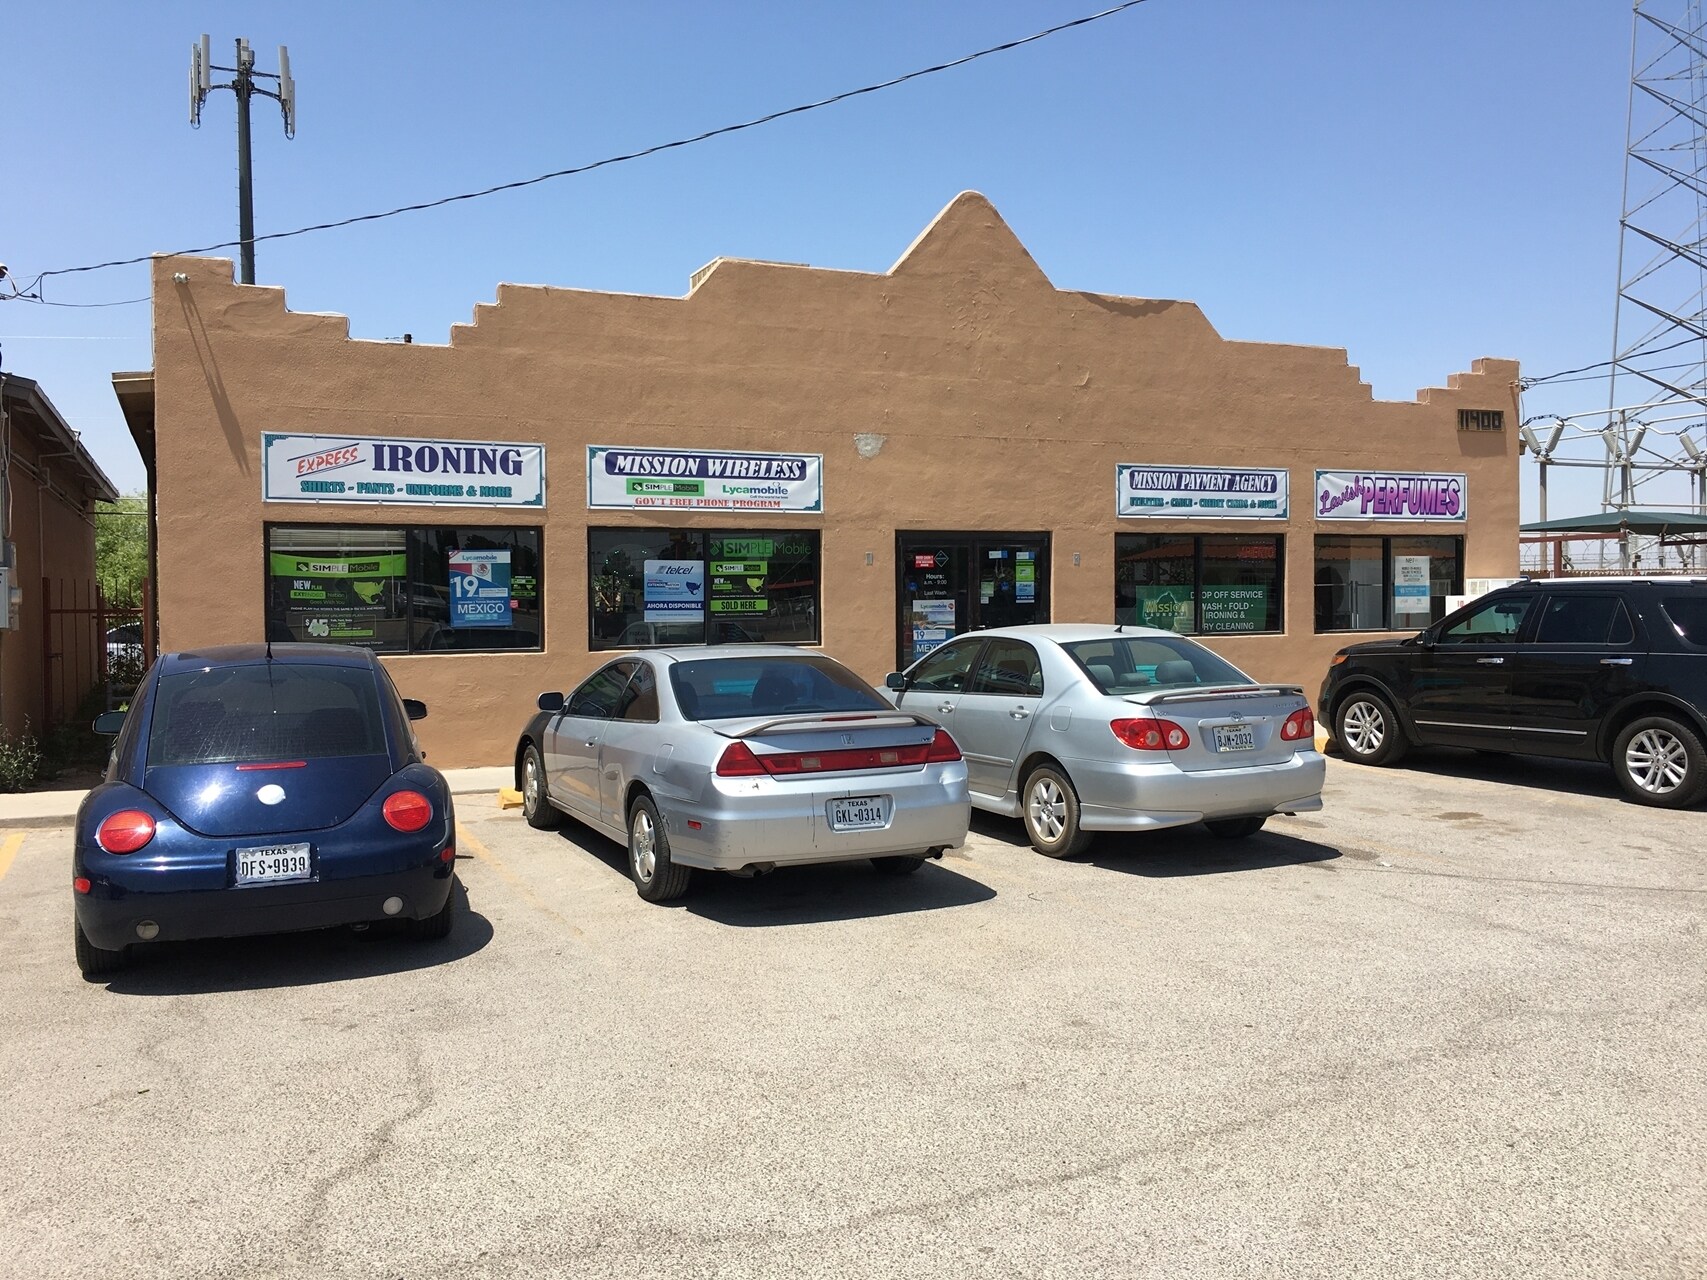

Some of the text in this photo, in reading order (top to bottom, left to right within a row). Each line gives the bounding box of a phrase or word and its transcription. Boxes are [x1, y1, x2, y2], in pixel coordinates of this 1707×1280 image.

[297, 446, 358, 475] EXPRESS
[372, 444, 523, 476] IRONING
[614, 455, 802, 479] MISSION WIRELESS
[1132, 472, 1275, 492] MISSION PAYMENT AGENCY
[301, 480, 345, 494] SHIRTS
[357, 482, 395, 495] PANTS
[406, 484, 463, 497] UNIFORMS
[466, 485, 477, 497] &
[479, 485, 512, 498] MORE
[644, 483, 673, 492] SIMPLE
[722, 484, 788, 496] Lycamobile
[1319, 475, 1365, 515] Lavish
[1360, 476, 1461, 516] PERFUMES
[635, 497, 781, 508] GOV'T FREE PHONE PROGRAM
[726, 541, 812, 555] SIMPLE Mobile
[312, 562, 379, 572] SIMPLE Mobile
[666, 566, 694, 575] telcel
[294, 580, 311, 590] NEW
[1190, 591, 1263, 599] DOP OFF SERVICE
[457, 603, 505, 614] MEXICO
[721, 601, 757, 610] SOLD HERE
[1229, 602, 1249, 610] FOLD
[1205, 611, 1246, 619] IRONING &
[1216, 622, 1254, 630] CLEANING
[915, 631, 925, 639] 19
[916, 644, 938, 653] MEX
[259, 848, 288, 856] TEXAS
